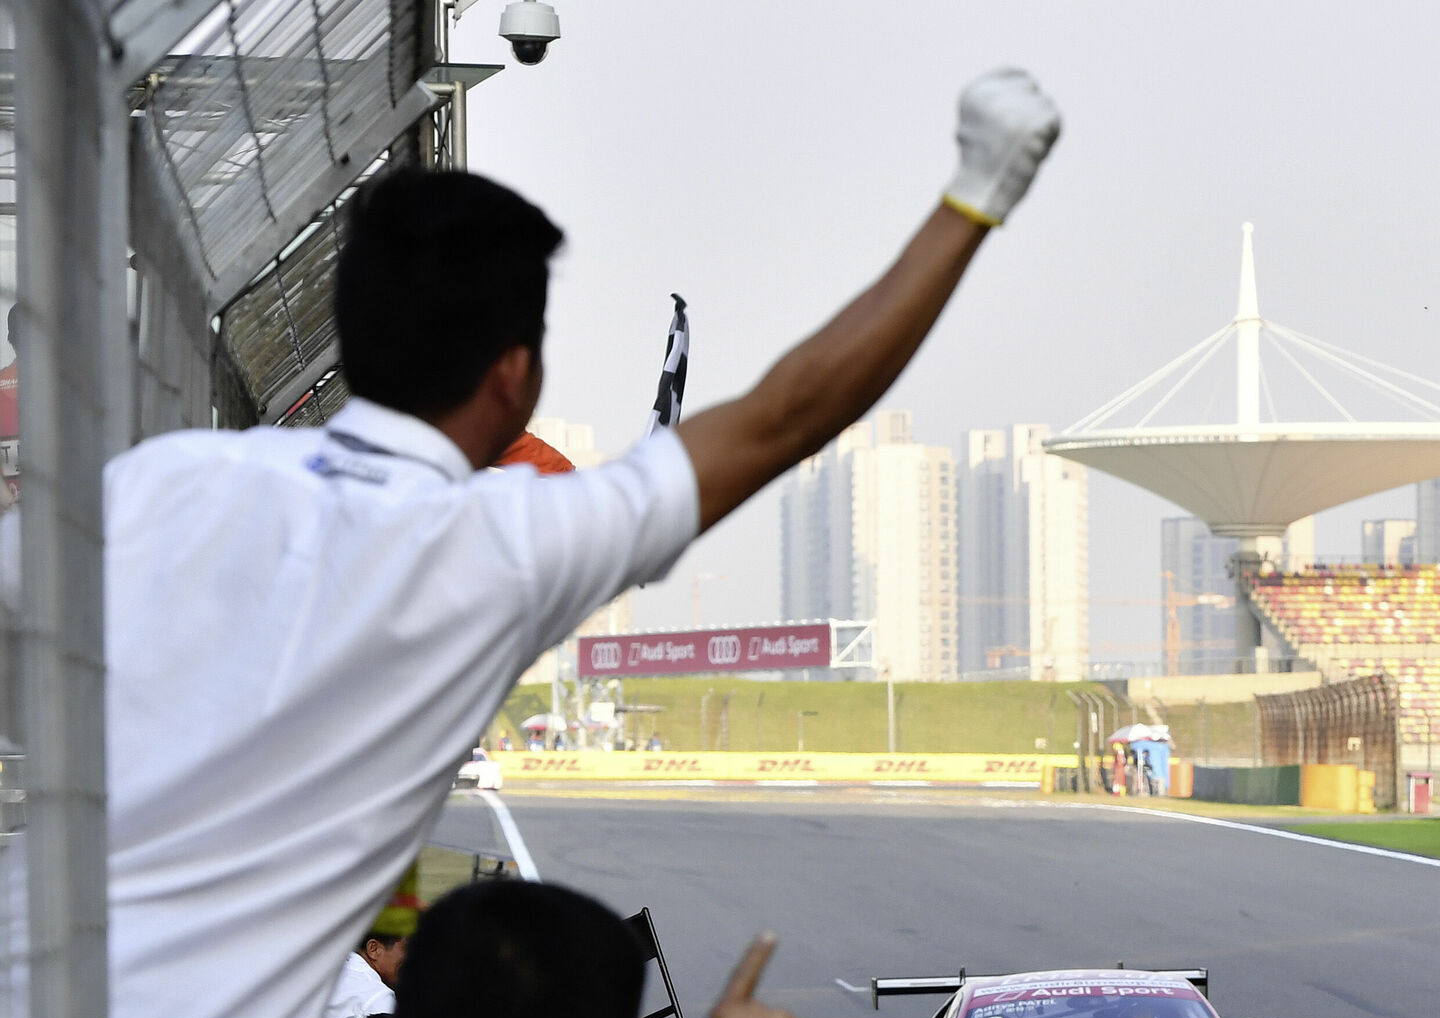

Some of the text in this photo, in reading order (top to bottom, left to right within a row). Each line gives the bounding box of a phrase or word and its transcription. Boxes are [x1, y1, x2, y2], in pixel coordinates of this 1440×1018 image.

[640, 641, 696, 663] Audi Sport
[761, 636, 819, 657] Audi Sport
[521, 757, 582, 772] DHL
[643, 757, 702, 772] DHL
[758, 759, 815, 772] DHL
[873, 760, 930, 773] DHL
[984, 760, 1040, 773] DHL
[1031, 985, 1175, 997] Audi Sport
